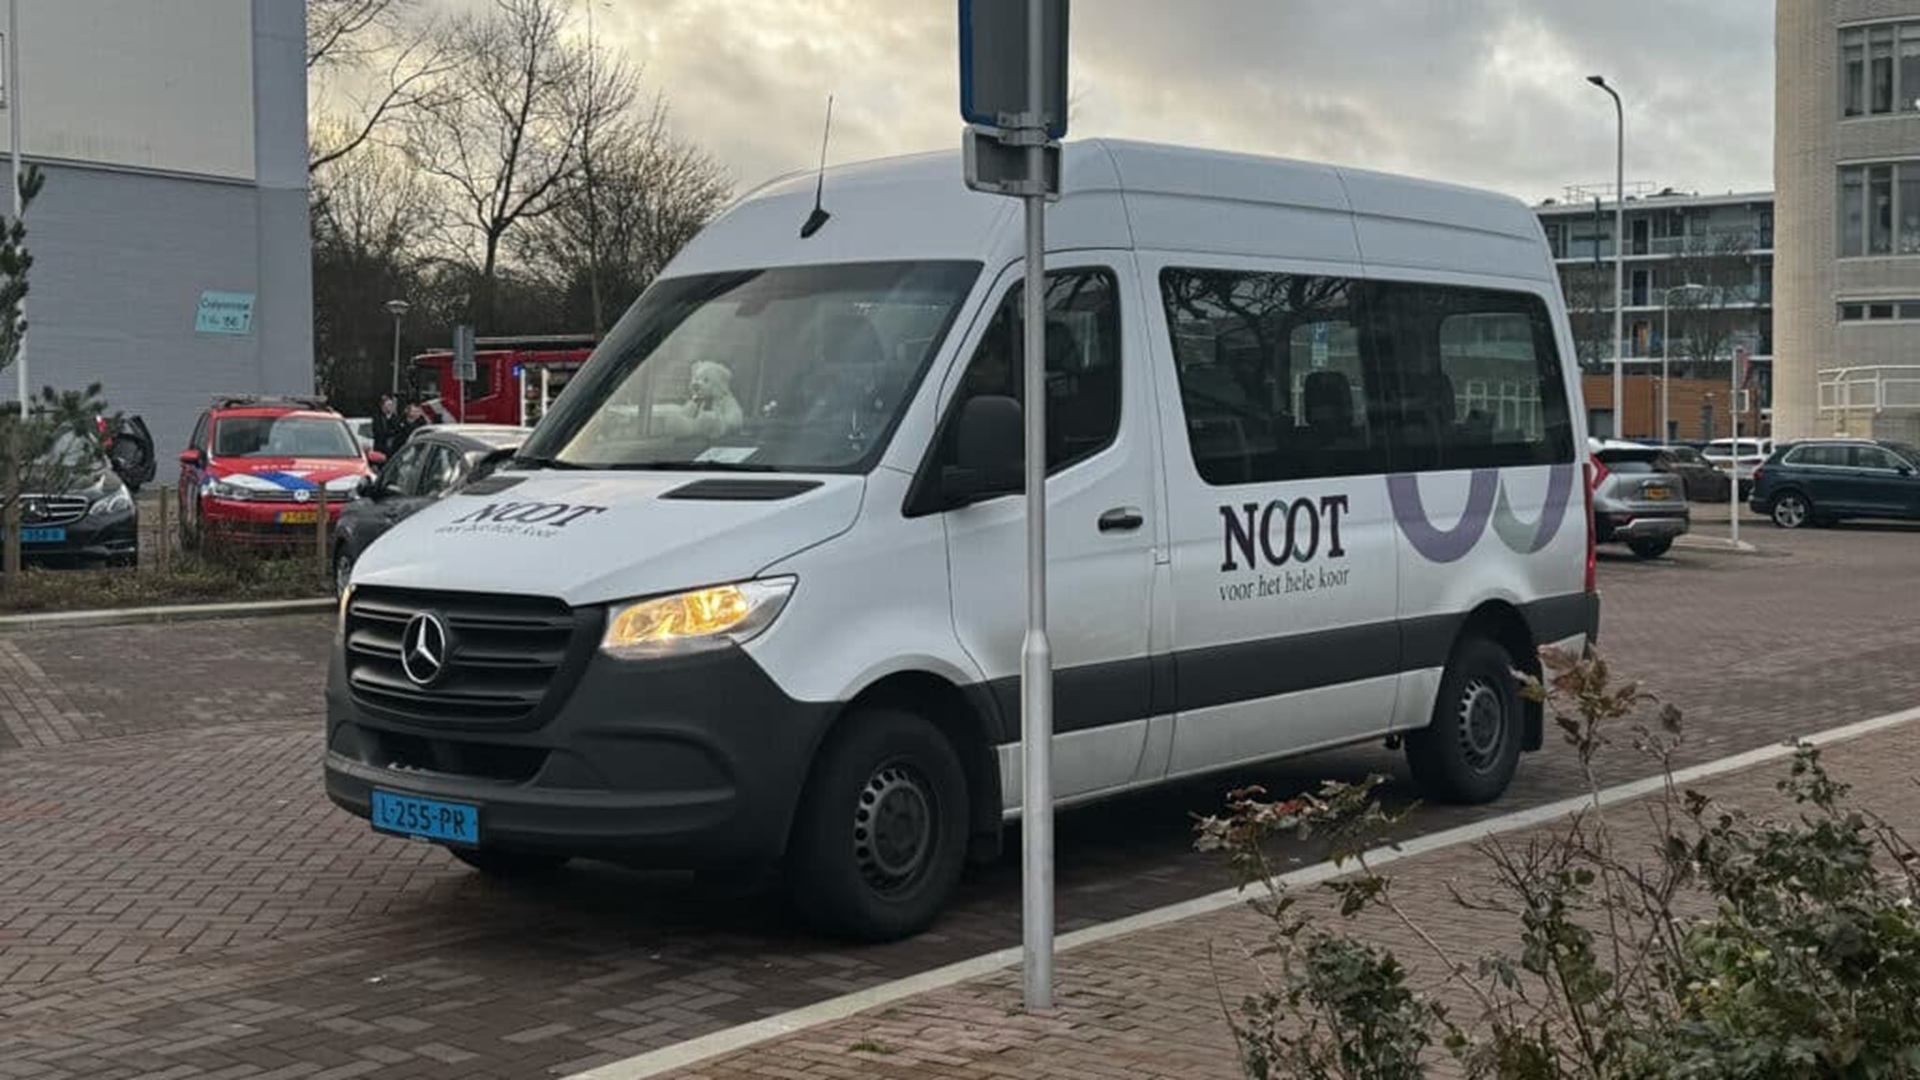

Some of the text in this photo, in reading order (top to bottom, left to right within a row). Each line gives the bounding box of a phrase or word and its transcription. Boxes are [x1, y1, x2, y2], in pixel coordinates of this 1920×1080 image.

[451, 502, 608, 527] NOOT
[1219, 494, 1349, 572] NOOT
[1219, 566, 1349, 601] voor het hele koor
[381, 797, 466, 836] L-255-PR
